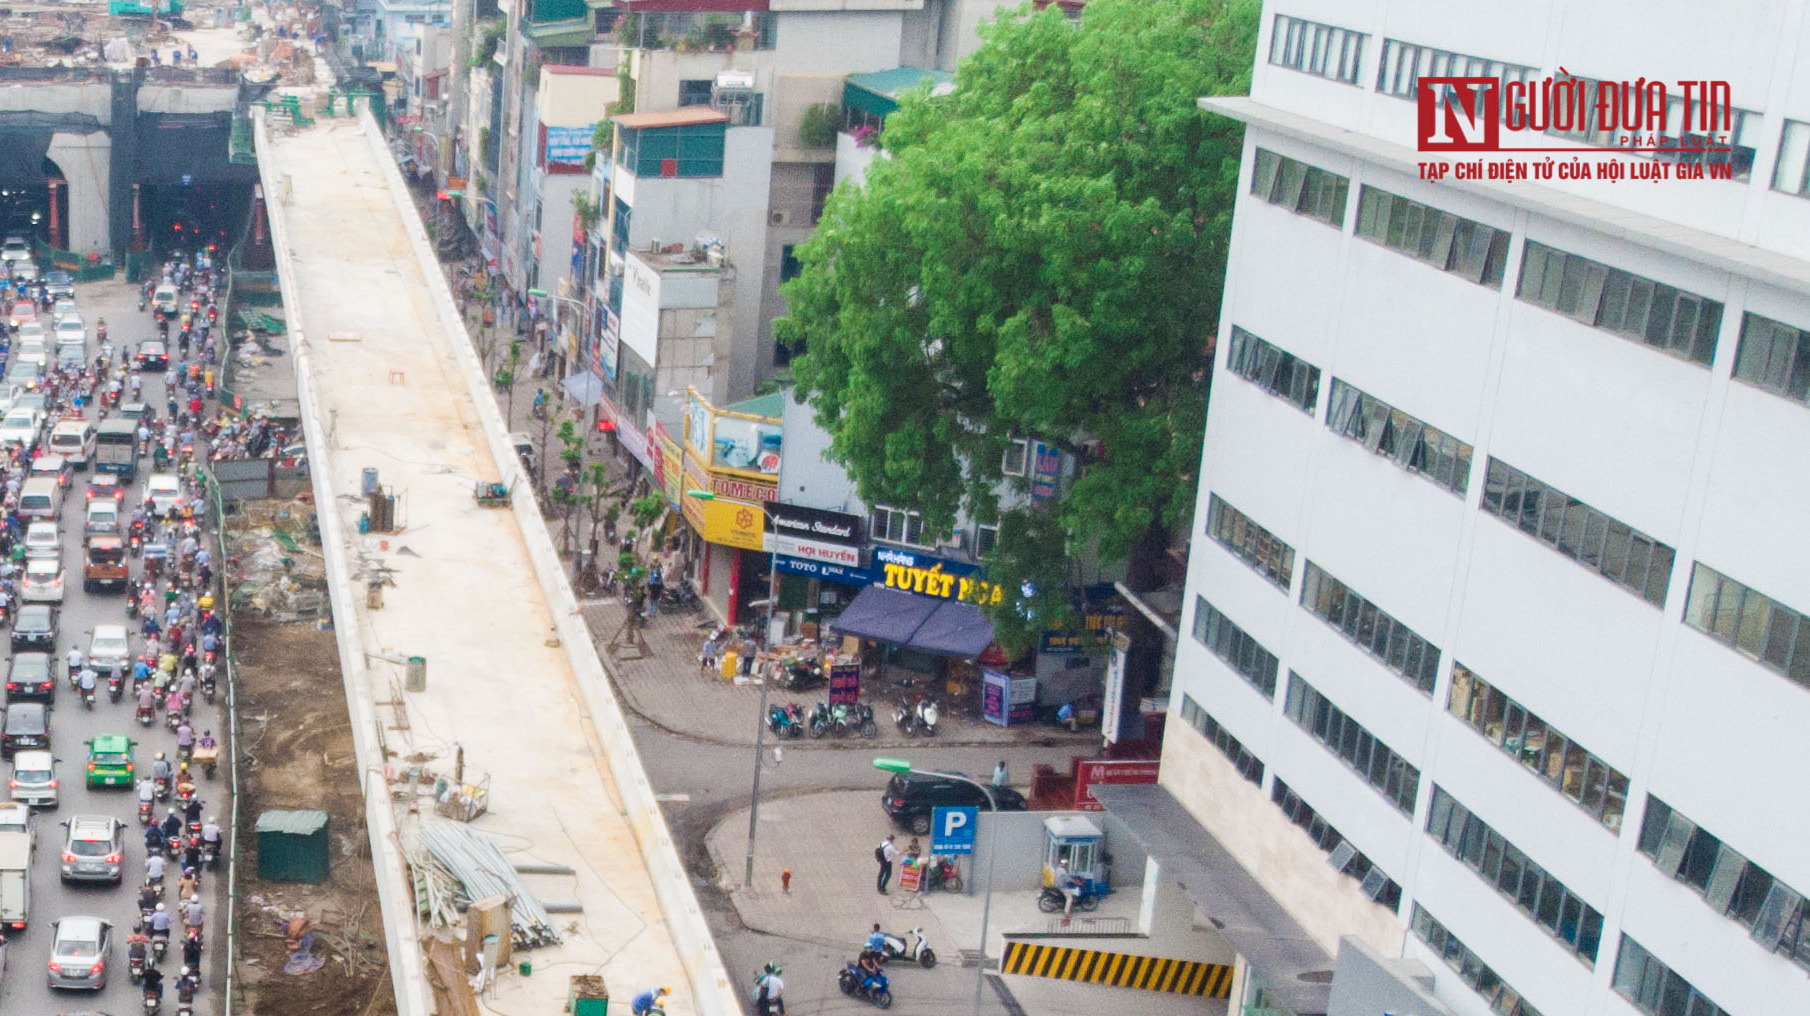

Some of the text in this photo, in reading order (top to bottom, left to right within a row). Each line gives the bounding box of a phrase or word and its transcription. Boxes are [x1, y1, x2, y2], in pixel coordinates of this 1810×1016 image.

[712, 479, 777, 501] TOMECO
[811, 520, 851, 537] Standard
[789, 560, 818, 573] TOTO
[883, 562, 956, 599] TUYẾT
[944, 811, 967, 837] P
